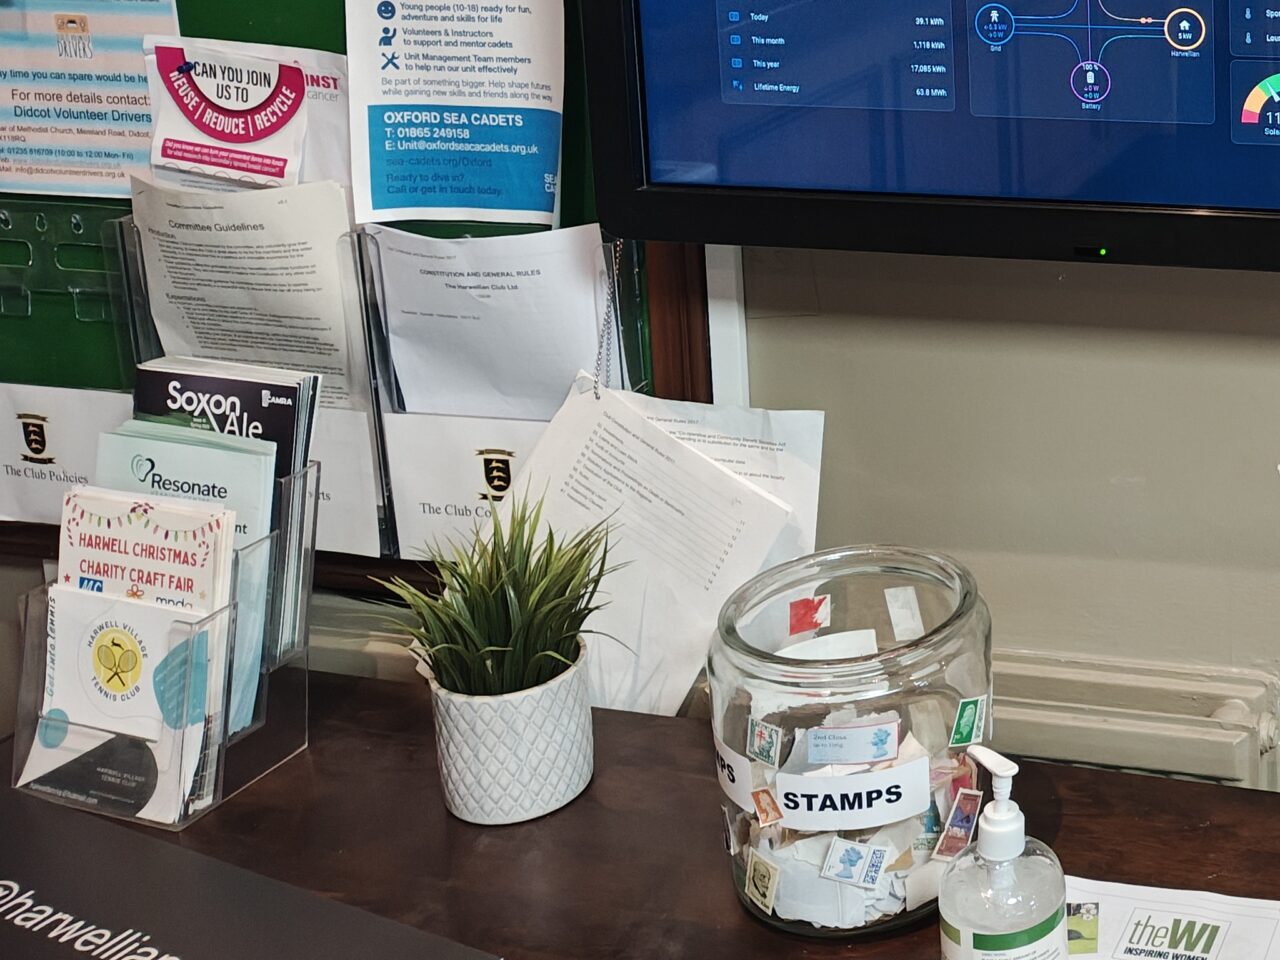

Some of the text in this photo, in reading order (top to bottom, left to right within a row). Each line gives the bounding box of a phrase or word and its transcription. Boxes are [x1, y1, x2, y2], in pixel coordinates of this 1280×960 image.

[400, 2, 532, 14] Young people (10-18) ready for fun,
[193, 61, 271, 88] CAN YOU JOIN
[11, 89, 151, 106] For more details contact:
[170, 70, 295, 135] REUSE REDUCE RECYCLE
[216, 83, 249, 103] US TO
[14, 106, 152, 123] Didcot Volunteer Drivers
[384, 112, 523, 126] OXFORD SEA CADETS
[385, 128, 470, 139] T: 01865 249158
[168, 219, 265, 232] Committee Guidelines
[167, 381, 240, 416] Soxon
[224, 411, 262, 439] Ale
[151, 472, 228, 499] Resonate
[79, 532, 198, 567] HARWELL CHRISTMAS
[79, 559, 194, 593] CHARITY CRAFT FAIR
[87, 620, 148, 658] HARWELL VILLAGE
[90, 676, 140, 702] TENNIS CLUB
[783, 784, 902, 812] STAMPS
[1124, 947, 1170, 960] INSPIRING
